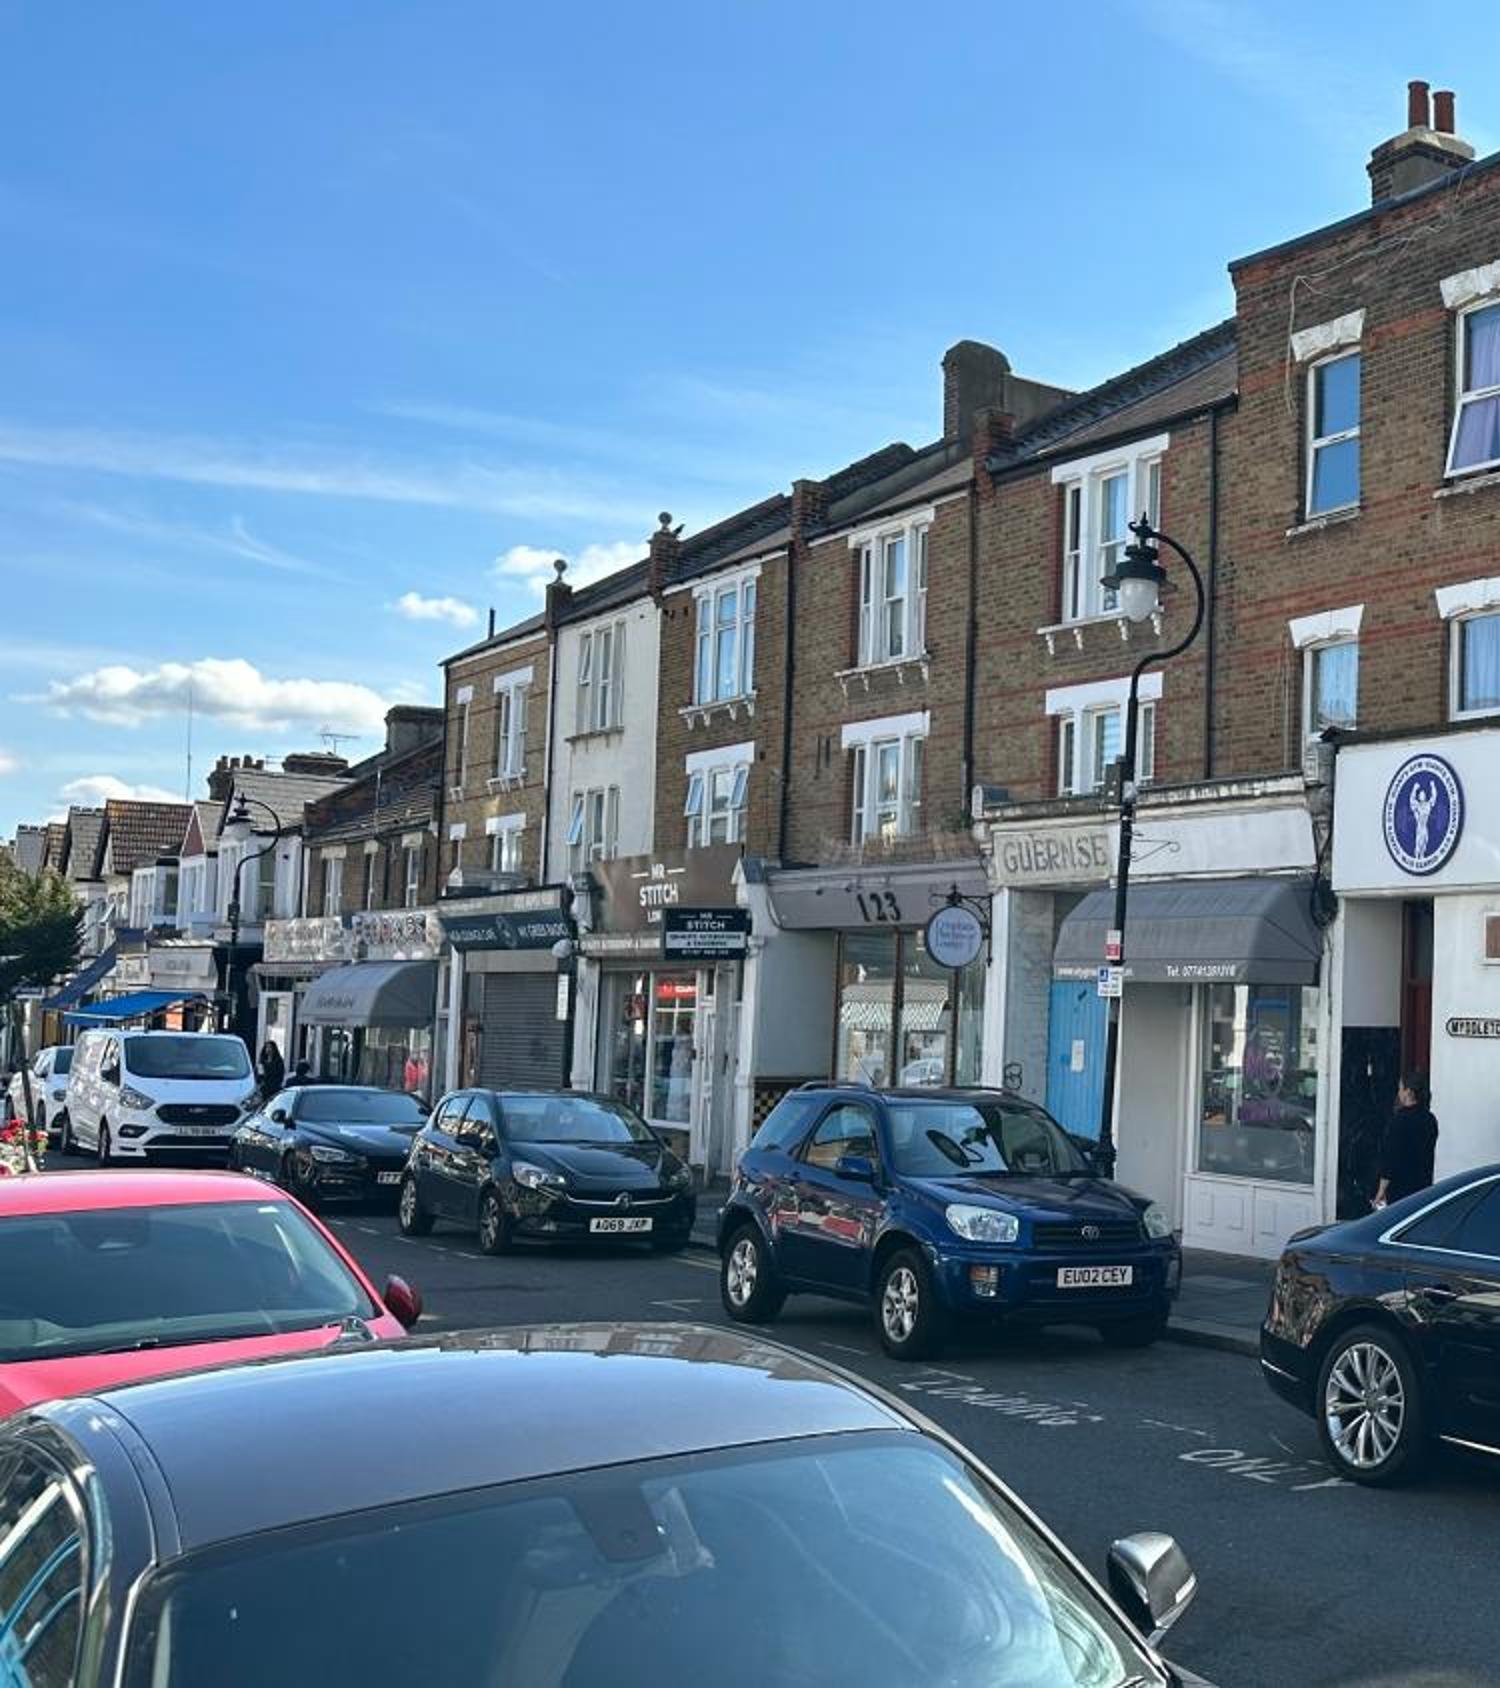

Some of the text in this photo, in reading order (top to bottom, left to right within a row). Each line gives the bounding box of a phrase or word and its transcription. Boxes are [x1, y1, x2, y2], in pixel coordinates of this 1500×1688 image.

[651, 864, 665, 880] MR
[639, 883, 679, 906] STITCH
[857, 892, 901, 922] 123
[687, 920, 725, 930] STITCH
[1064, 1267, 1128, 1285] EU02 CEY
